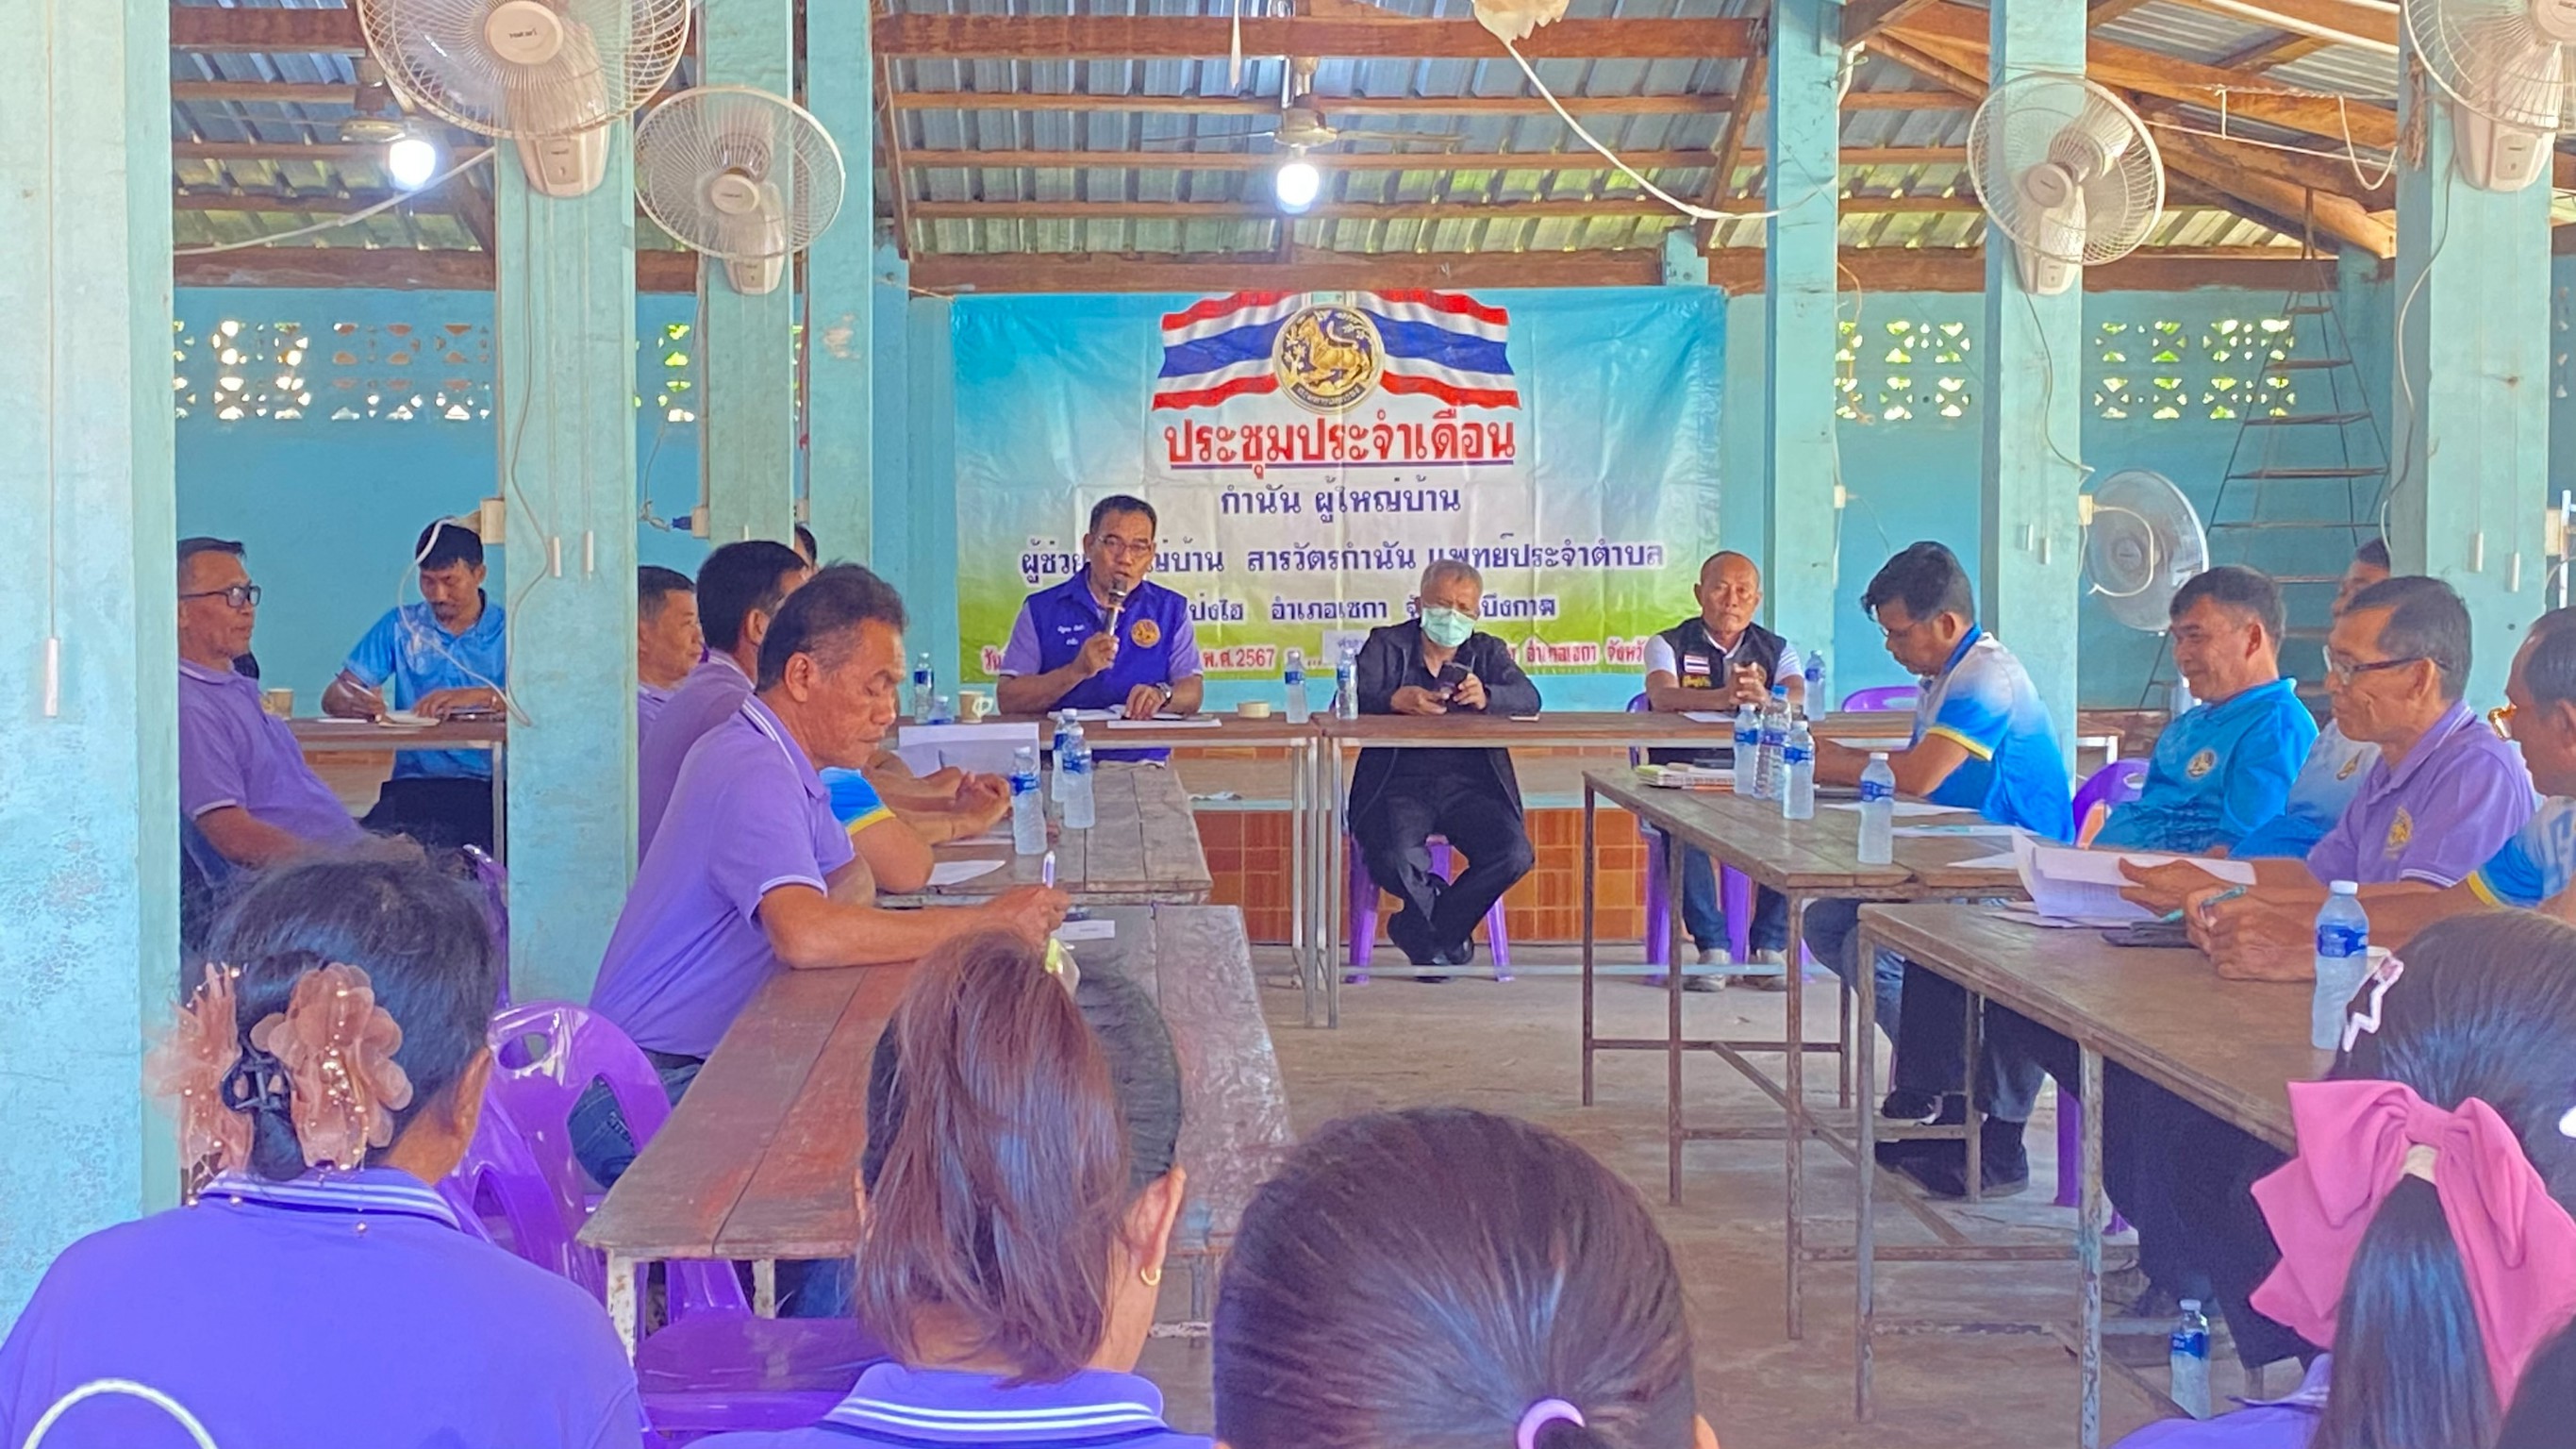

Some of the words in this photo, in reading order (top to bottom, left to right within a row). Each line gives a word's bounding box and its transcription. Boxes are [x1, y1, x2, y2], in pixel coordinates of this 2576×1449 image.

[1164, 408, 1516, 479] ประชุมประจำเดือน
[1221, 484, 1302, 514] กำนัน
[1315, 475, 1461, 524] ผู้ใหญ่บ้าน
[1247, 541, 1416, 571] สารวัตรกำนัน
[1188, 592, 1244, 621] ป่งไฮ
[1271, 595, 1388, 620] อำเภอเซกา
[1607, 639, 1647, 662] จังหวั
